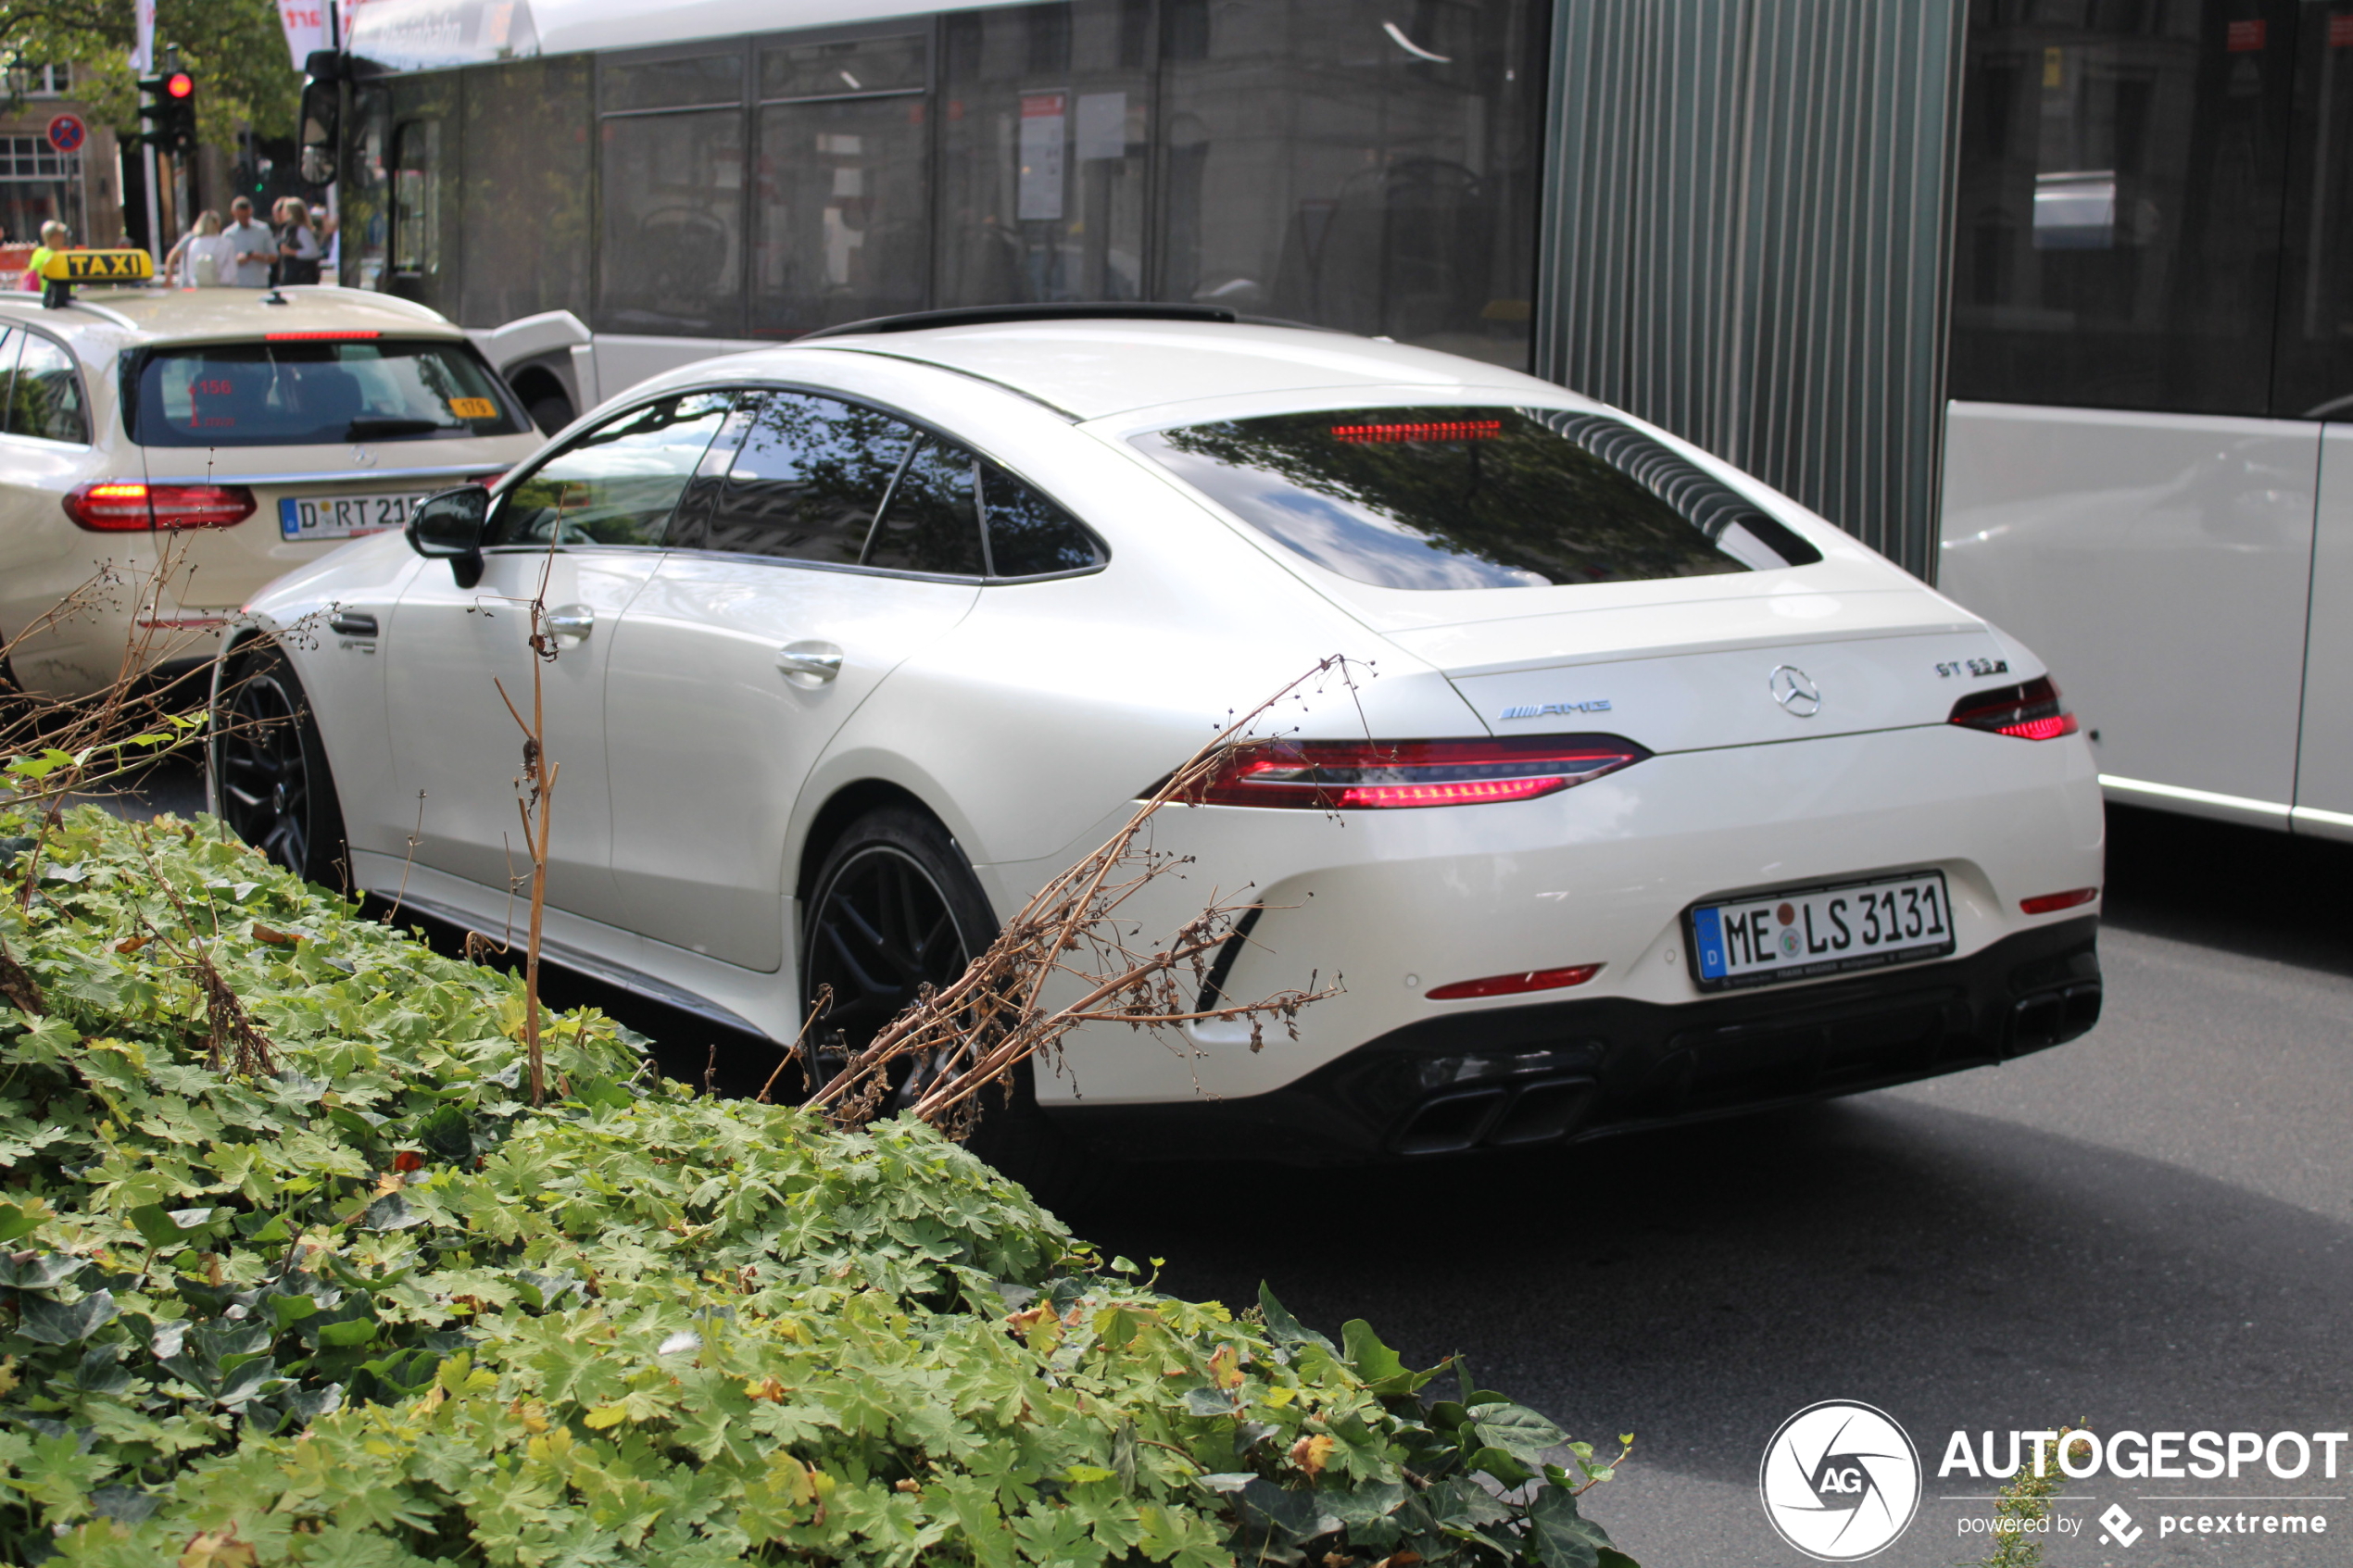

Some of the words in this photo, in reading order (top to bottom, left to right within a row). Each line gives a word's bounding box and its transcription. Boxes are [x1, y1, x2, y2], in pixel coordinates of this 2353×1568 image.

[69, 255, 140, 276] TAXI
[299, 502, 317, 528] D
[335, 500, 370, 526] RT
[1935, 661, 1961, 677] GT
[1537, 699, 1612, 717] AMG
[1724, 909, 1777, 966] ME
[1804, 898, 1851, 954] LS
[1858, 884, 1945, 946] 3131
[1706, 949, 1718, 966] D
